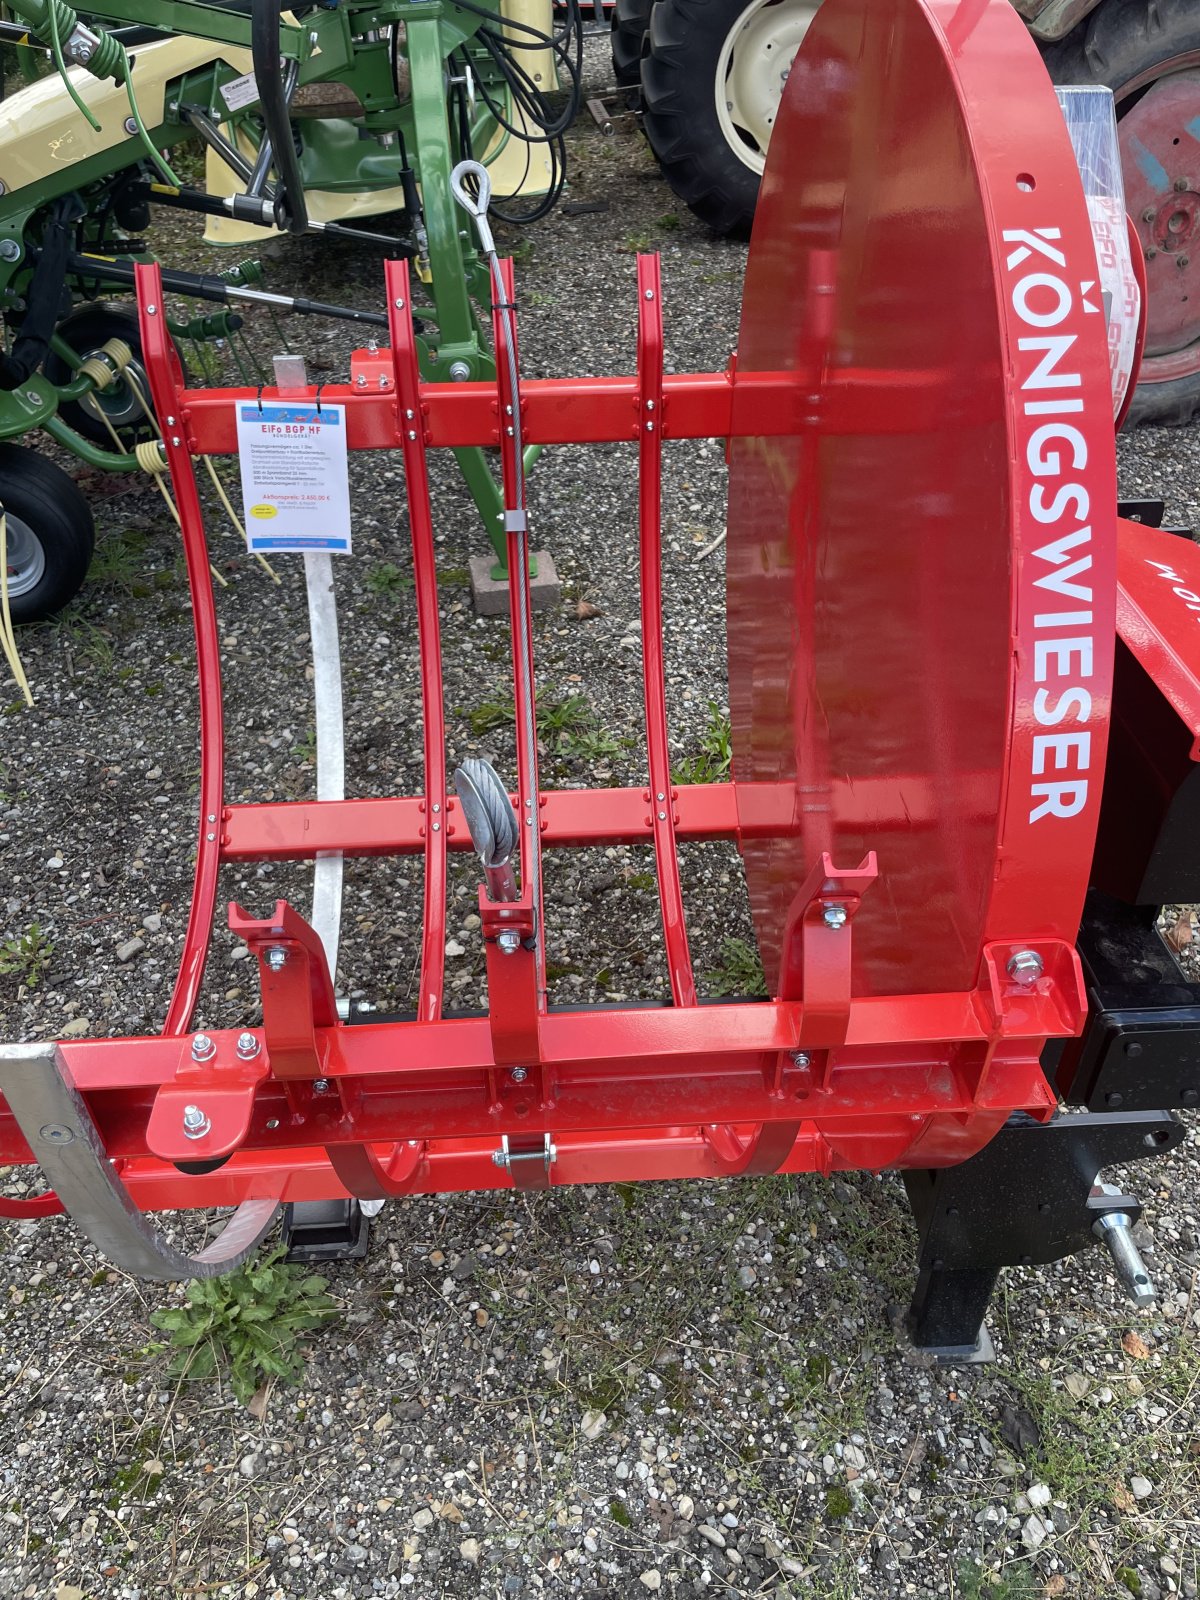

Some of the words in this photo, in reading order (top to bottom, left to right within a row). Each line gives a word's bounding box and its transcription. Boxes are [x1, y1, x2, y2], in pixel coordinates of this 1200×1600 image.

[261, 424, 282, 433] EiFo
[285, 425, 305, 434] BGP
[308, 426, 321, 435] HF
[1002, 227, 1100, 824] KÖNIGSWIESER
